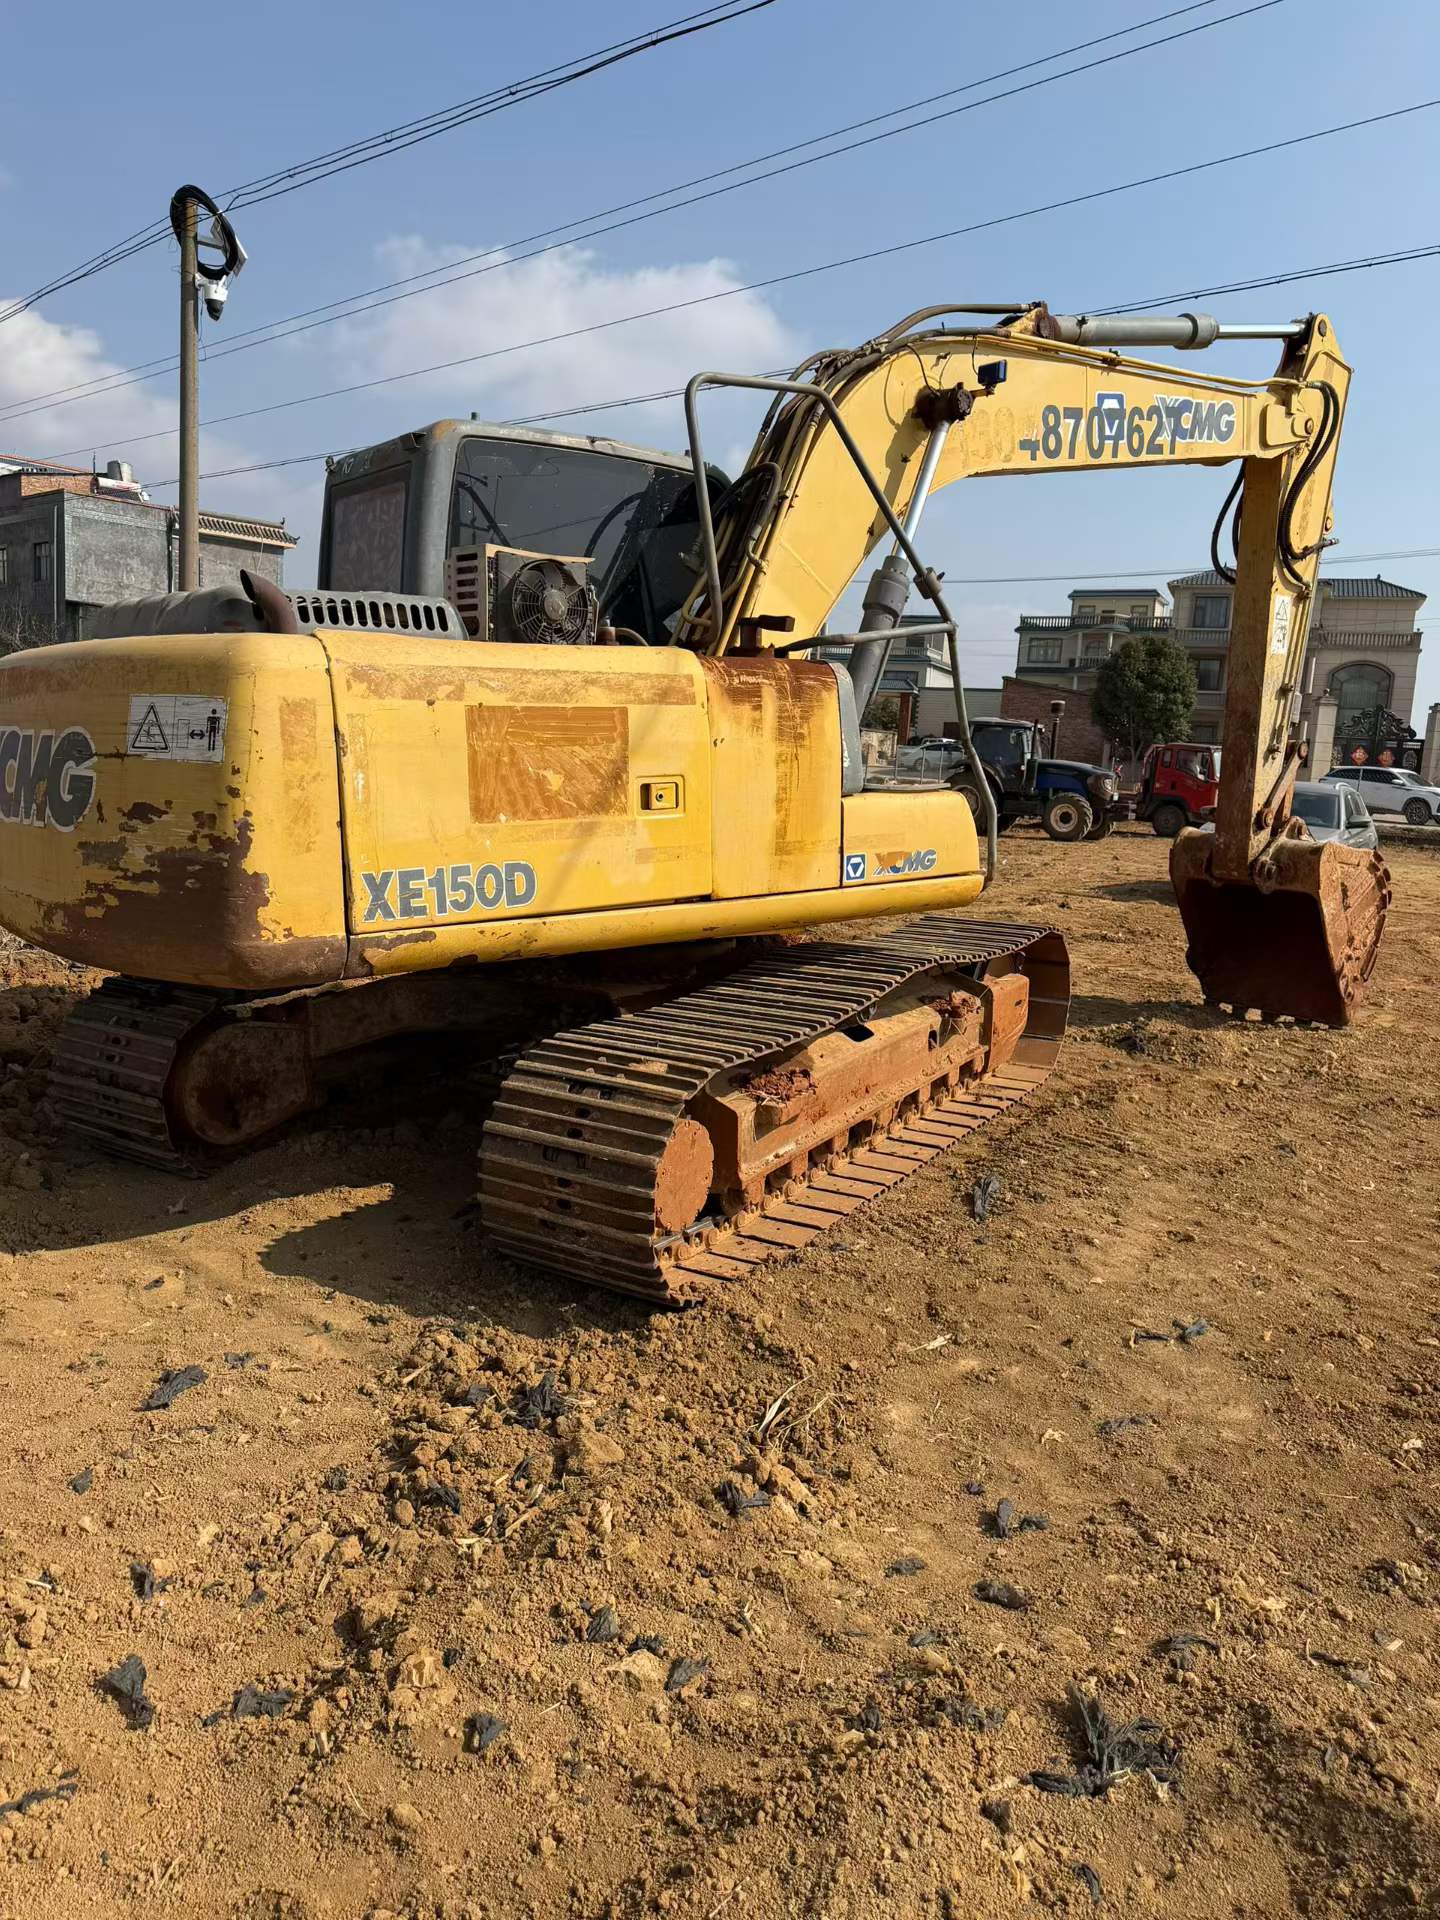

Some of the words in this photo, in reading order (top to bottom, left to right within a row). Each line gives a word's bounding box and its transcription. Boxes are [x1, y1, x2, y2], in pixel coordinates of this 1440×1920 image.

[1154, 394, 1235, 442] XCMG
[0, 726, 97, 832] CMG
[361, 861, 537, 922] XE150D
